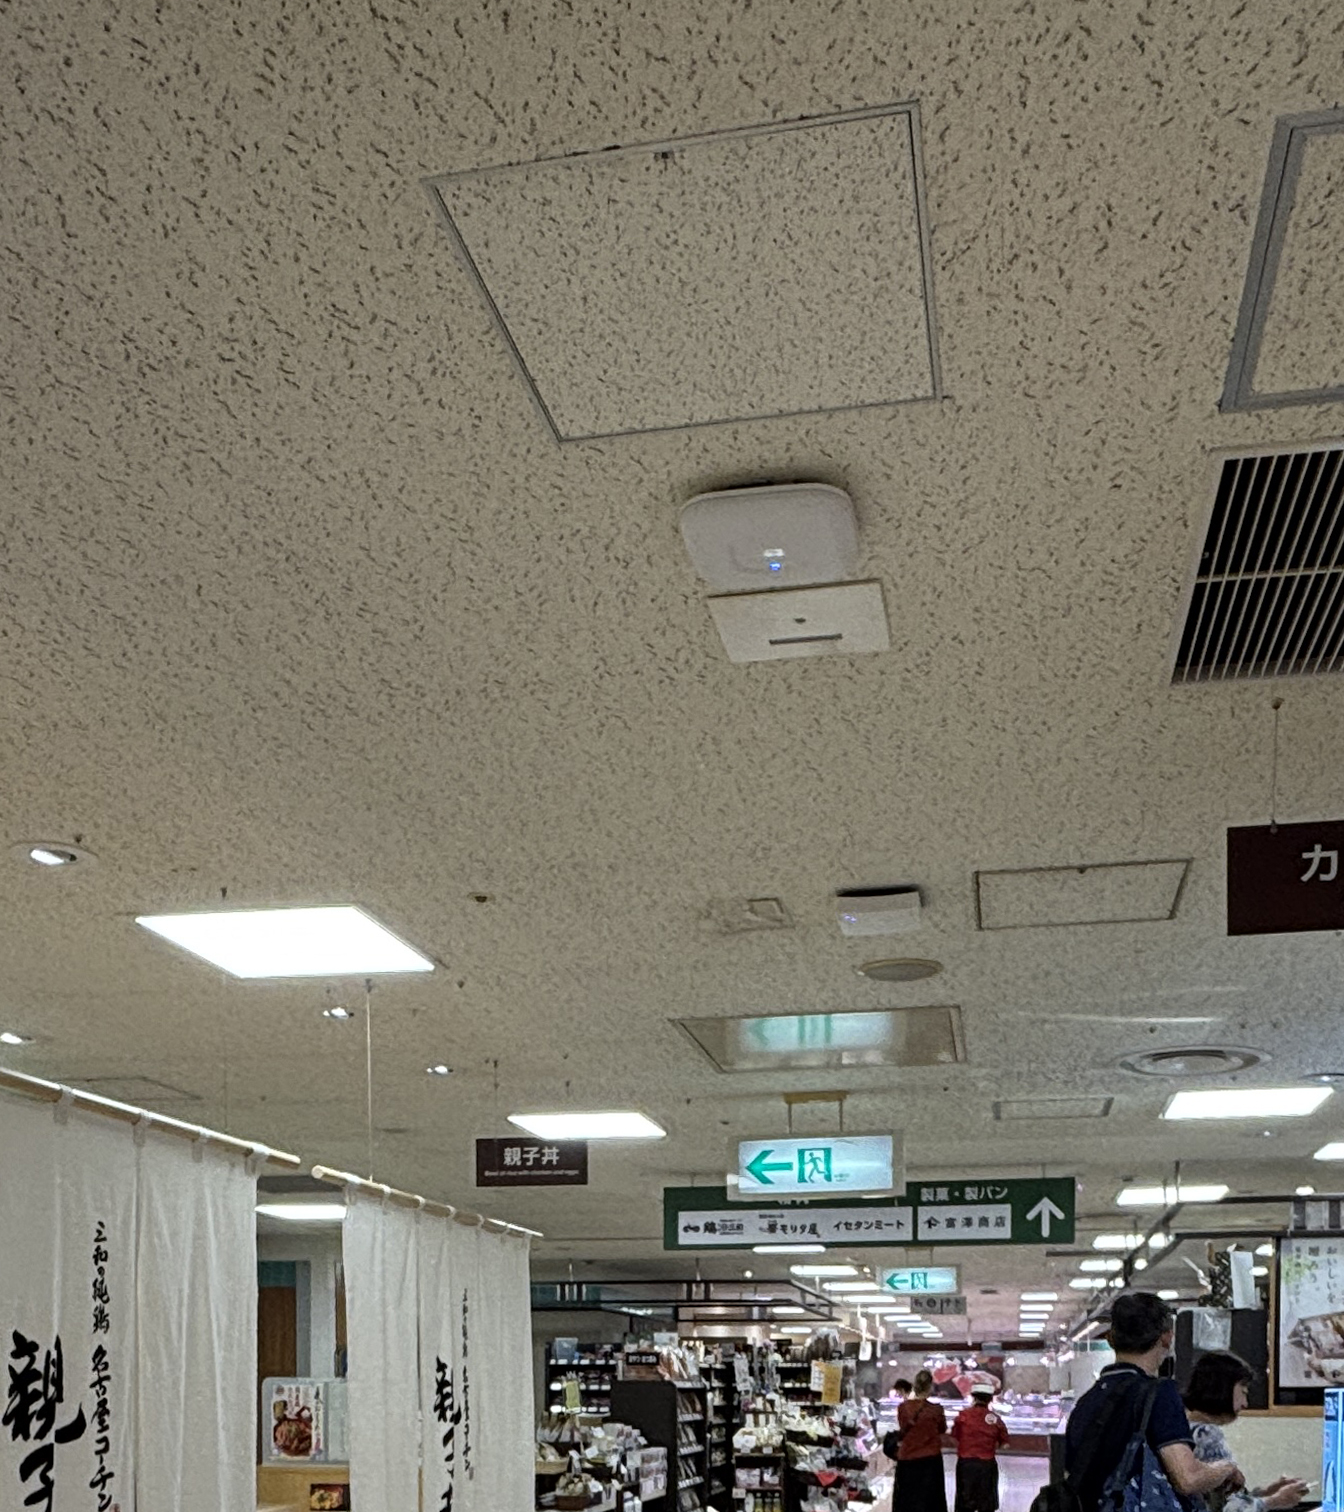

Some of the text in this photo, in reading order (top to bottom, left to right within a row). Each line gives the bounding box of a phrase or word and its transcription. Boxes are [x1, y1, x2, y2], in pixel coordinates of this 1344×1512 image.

[503, 1145, 560, 1167] 親子丼
[920, 1185, 1008, 1202] 製菓・製パン
[833, 1219, 905, 1232] イセタンミート
